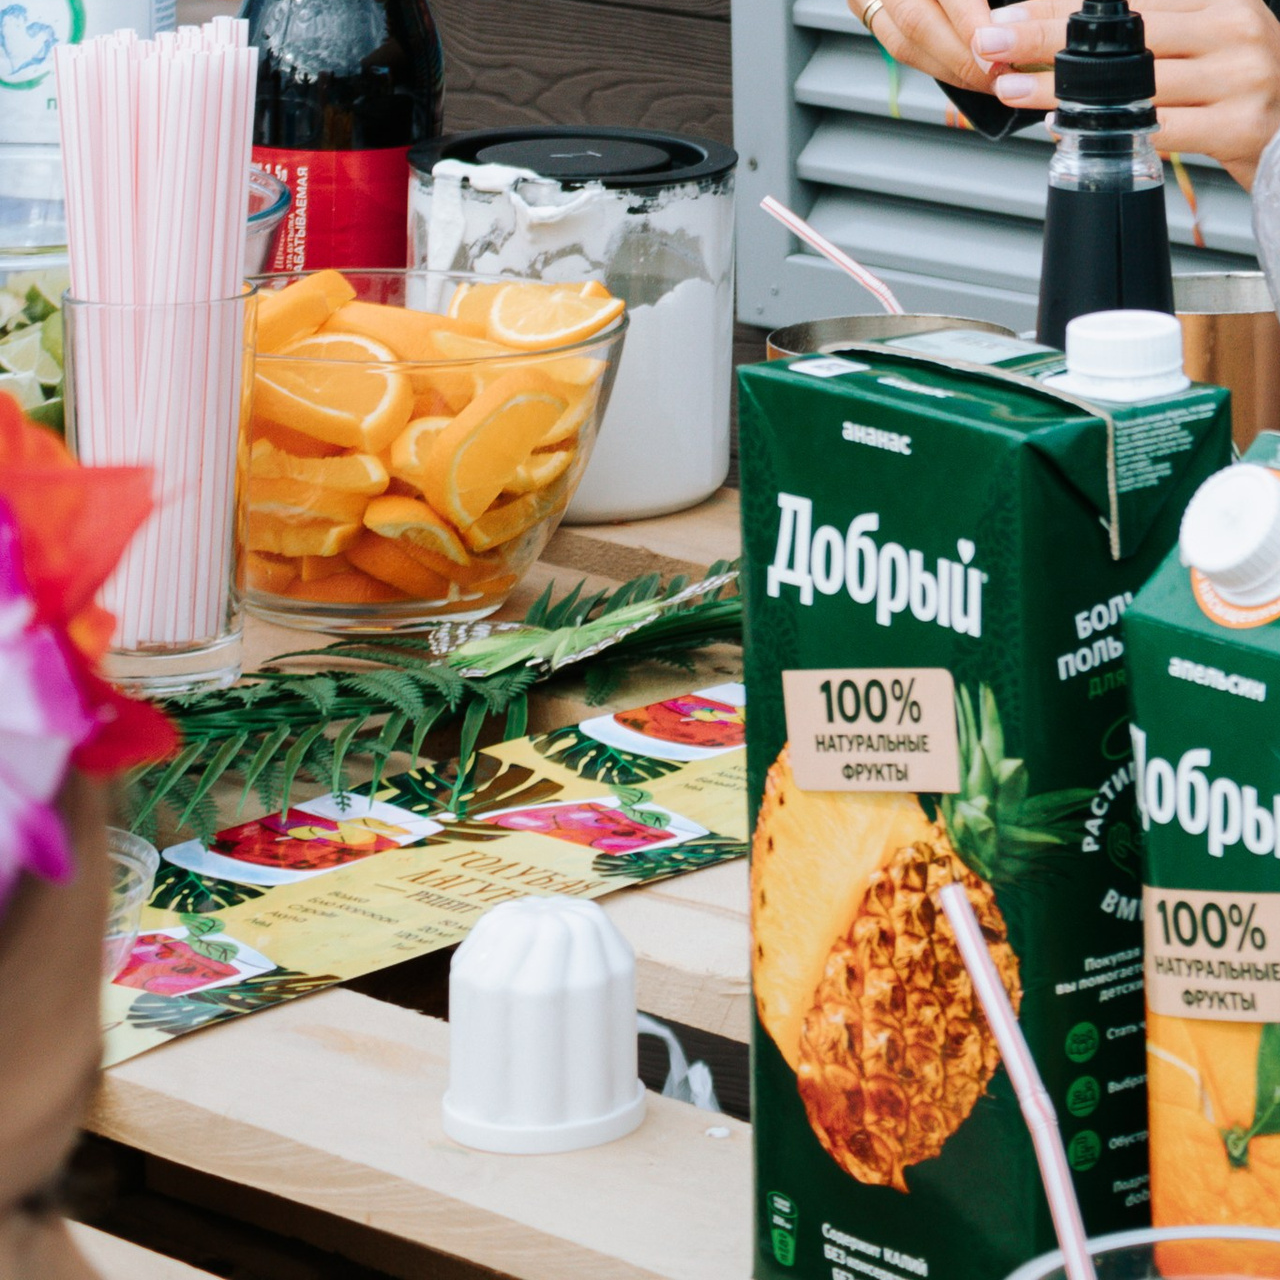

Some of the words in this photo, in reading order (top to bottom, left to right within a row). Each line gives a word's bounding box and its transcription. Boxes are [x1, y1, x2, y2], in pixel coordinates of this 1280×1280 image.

[841, 420, 913, 456] ананас
[766, 492, 984, 639] Добрый
[820, 677, 922, 725] 100%
[1167, 655, 1267, 703] апельсин
[815, 733, 930, 754] НАТУРАЛЬНЫЕ
[841, 763, 910, 782] ФРУКТЫ
[440, 849, 611, 897] ГОЛУБАЯ
[1156, 899, 1267, 953] 100%
[1182, 989, 1259, 1013] ФРУКТЫ
